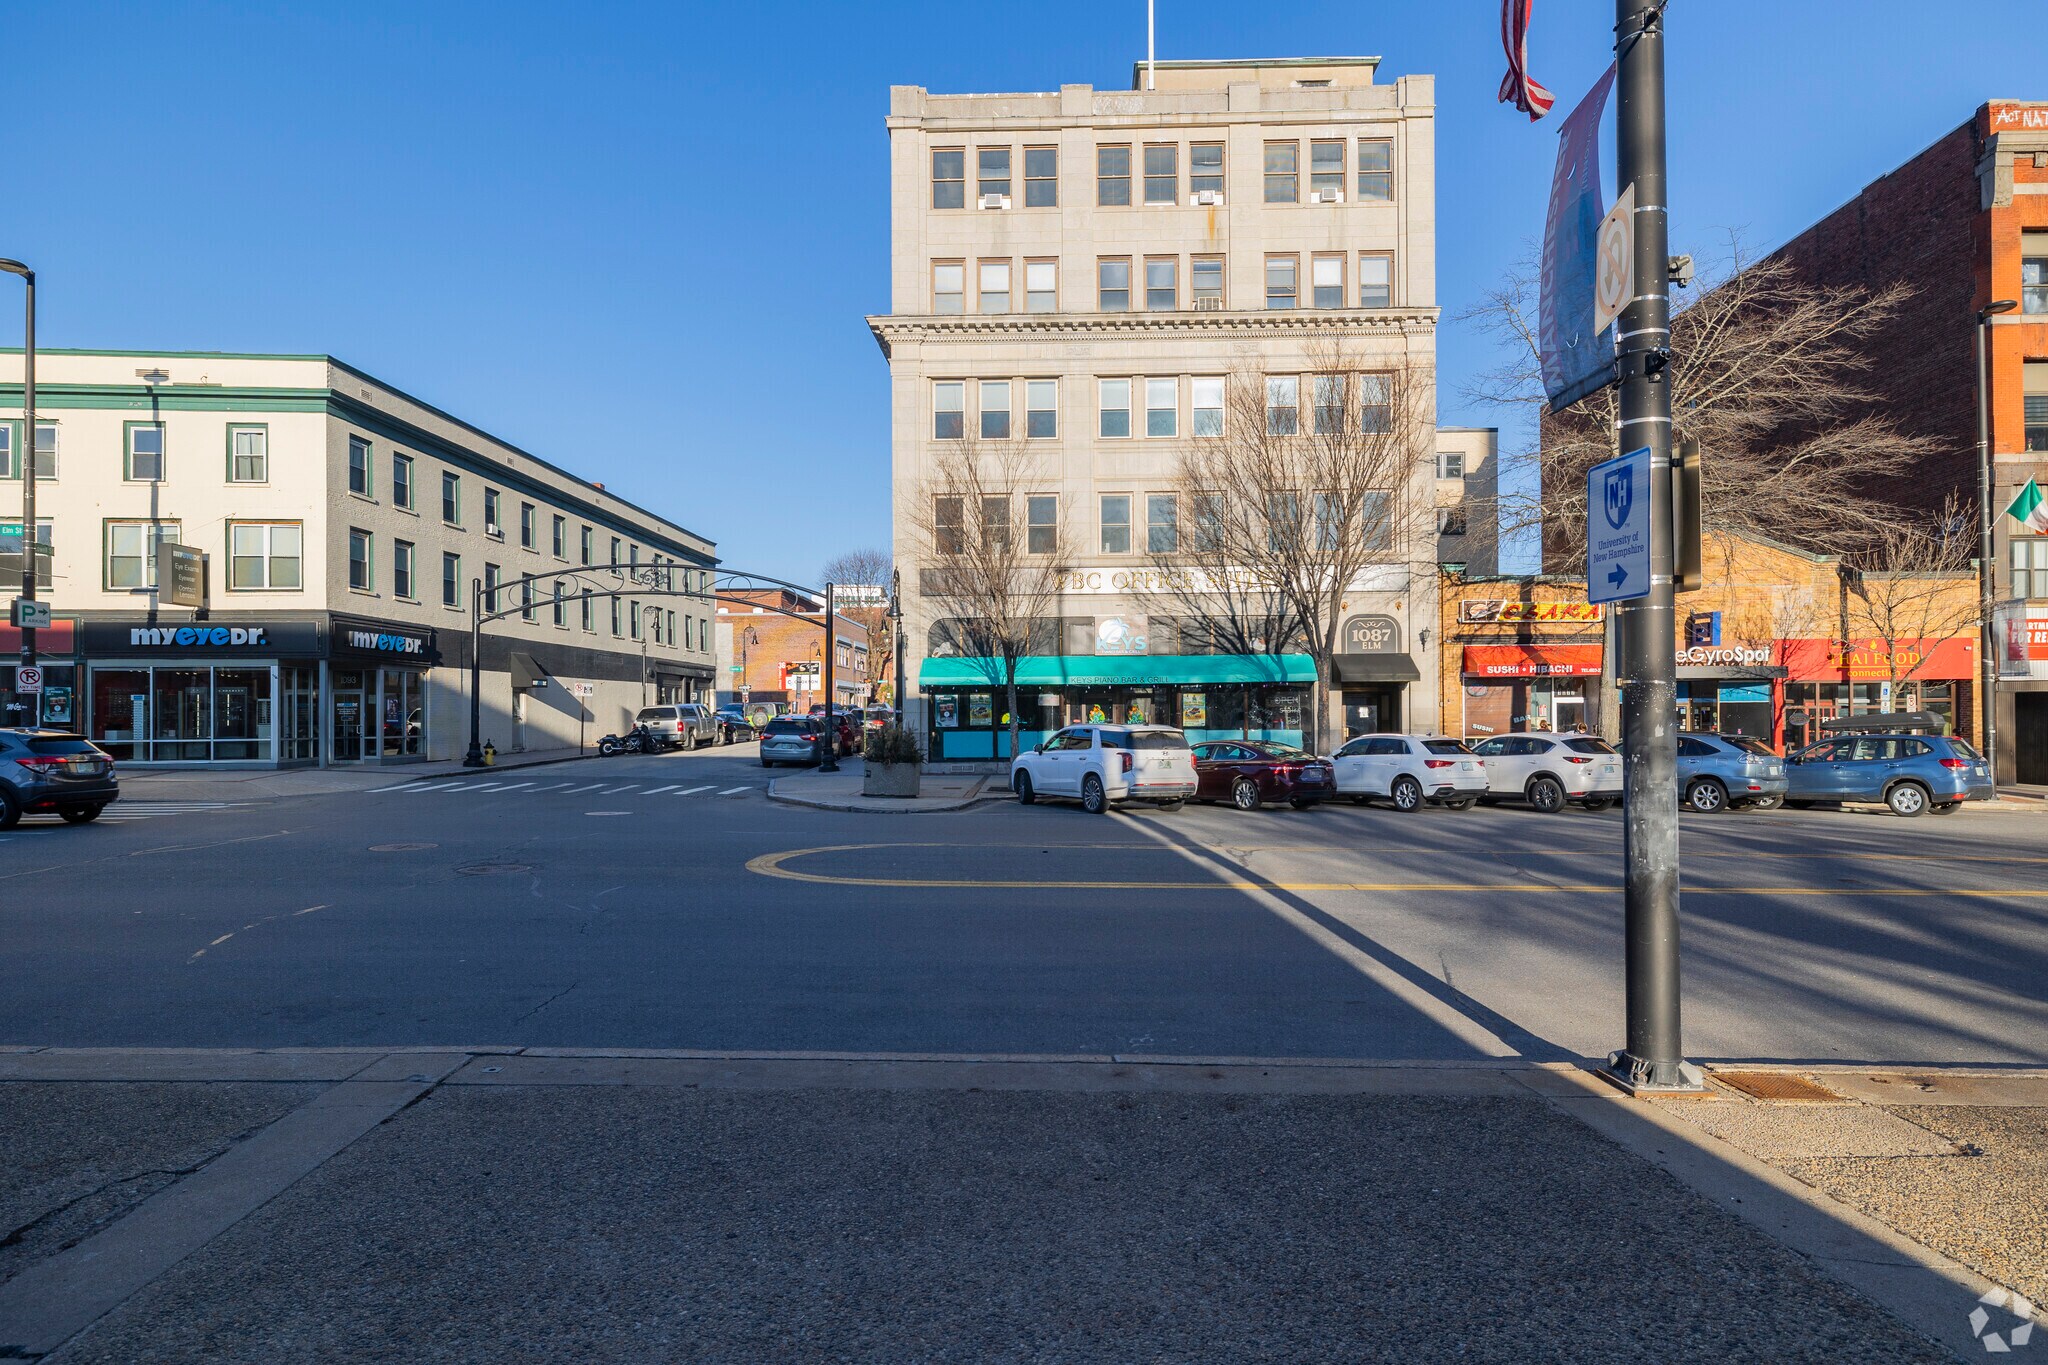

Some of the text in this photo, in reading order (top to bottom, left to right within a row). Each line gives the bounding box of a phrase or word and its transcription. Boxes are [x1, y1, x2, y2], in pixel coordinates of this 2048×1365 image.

[1540, 127, 1572, 391] MANCHESTER
[1609, 479, 1627, 509] NH
[1598, 531, 1639, 550] University of
[1593, 544, 1644, 564] New Hampshire
[1050, 572, 1102, 589] WBC
[1111, 572, 1196, 589] OFFICE
[1503, 603, 1600, 620] OSAKA
[1351, 628, 1392, 642] 1087
[2011, 631, 2032, 644] FOR
[1096, 636, 1147, 651] KEYS
[1362, 641, 1382, 650] ELM
[1830, 652, 1920, 665] THAI FOOD
[1487, 665, 1519, 674] SUSHI
[1529, 665, 1573, 674] HIBACHI
[1070, 676, 1170, 684] KEYS PIANO BAR & GRILL
[1513, 714, 1531, 723] BAR
[1472, 723, 1494, 733] SUSHI
